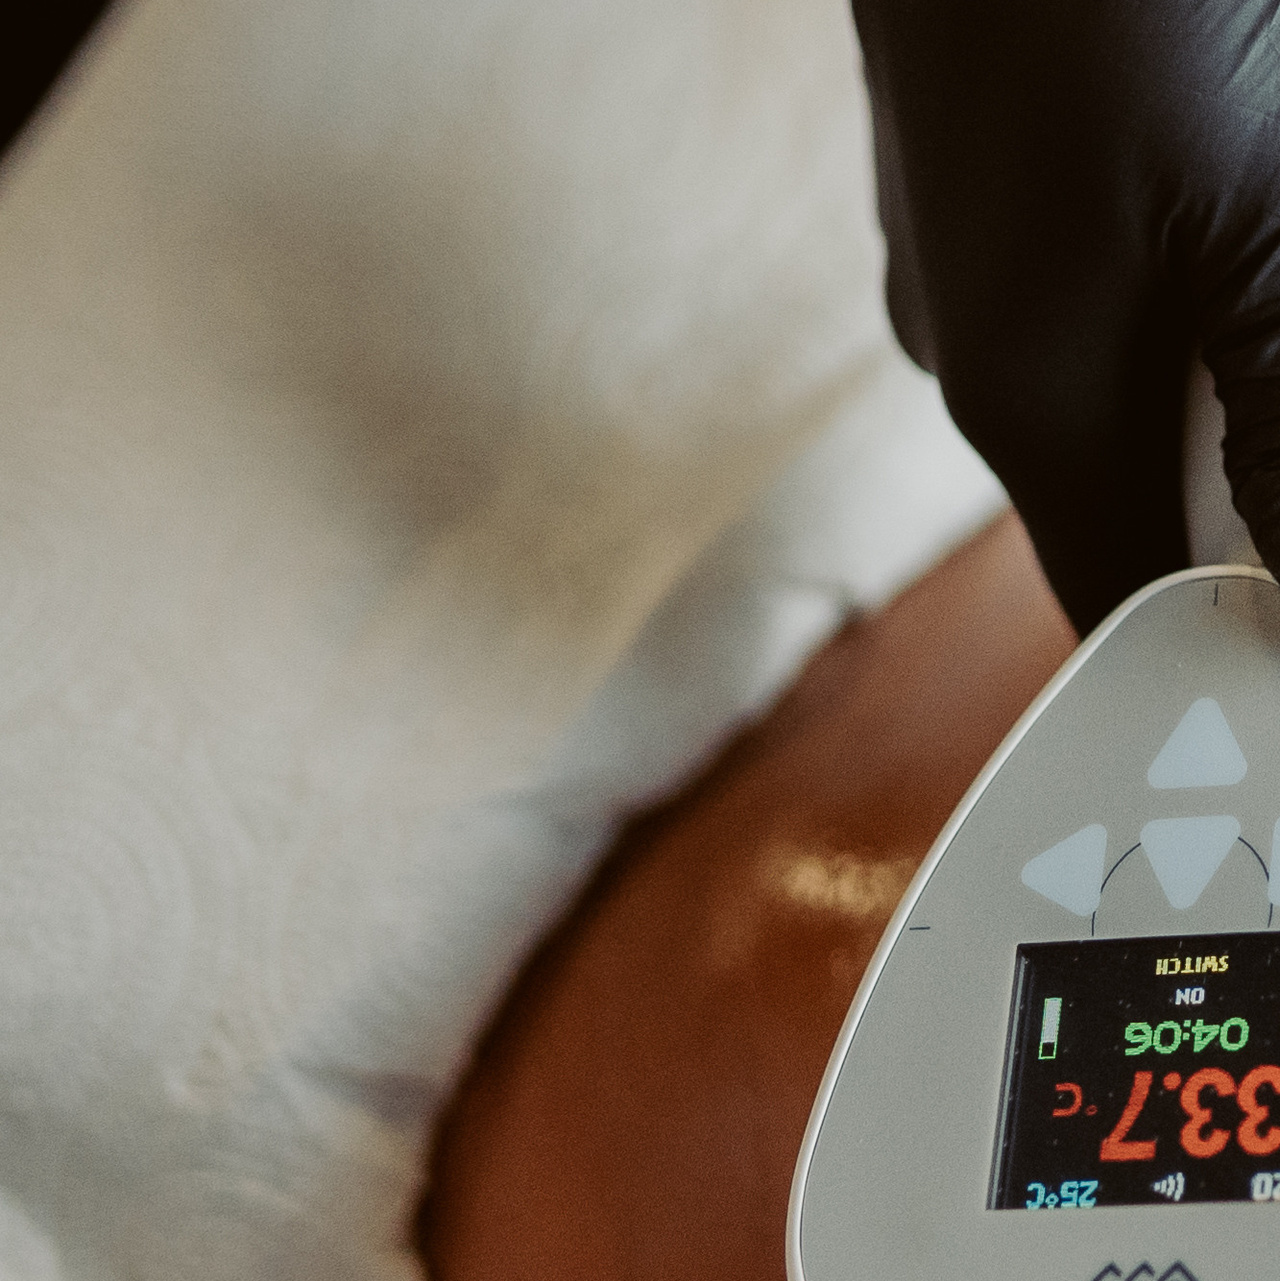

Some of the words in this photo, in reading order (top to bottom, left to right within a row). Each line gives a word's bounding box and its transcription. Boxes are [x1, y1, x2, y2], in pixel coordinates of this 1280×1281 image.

[1155, 955, 1229, 975] SWITCH
[1175, 987, 1205, 1005] ON
[1124, 1017, 1250, 1055] 04:06
